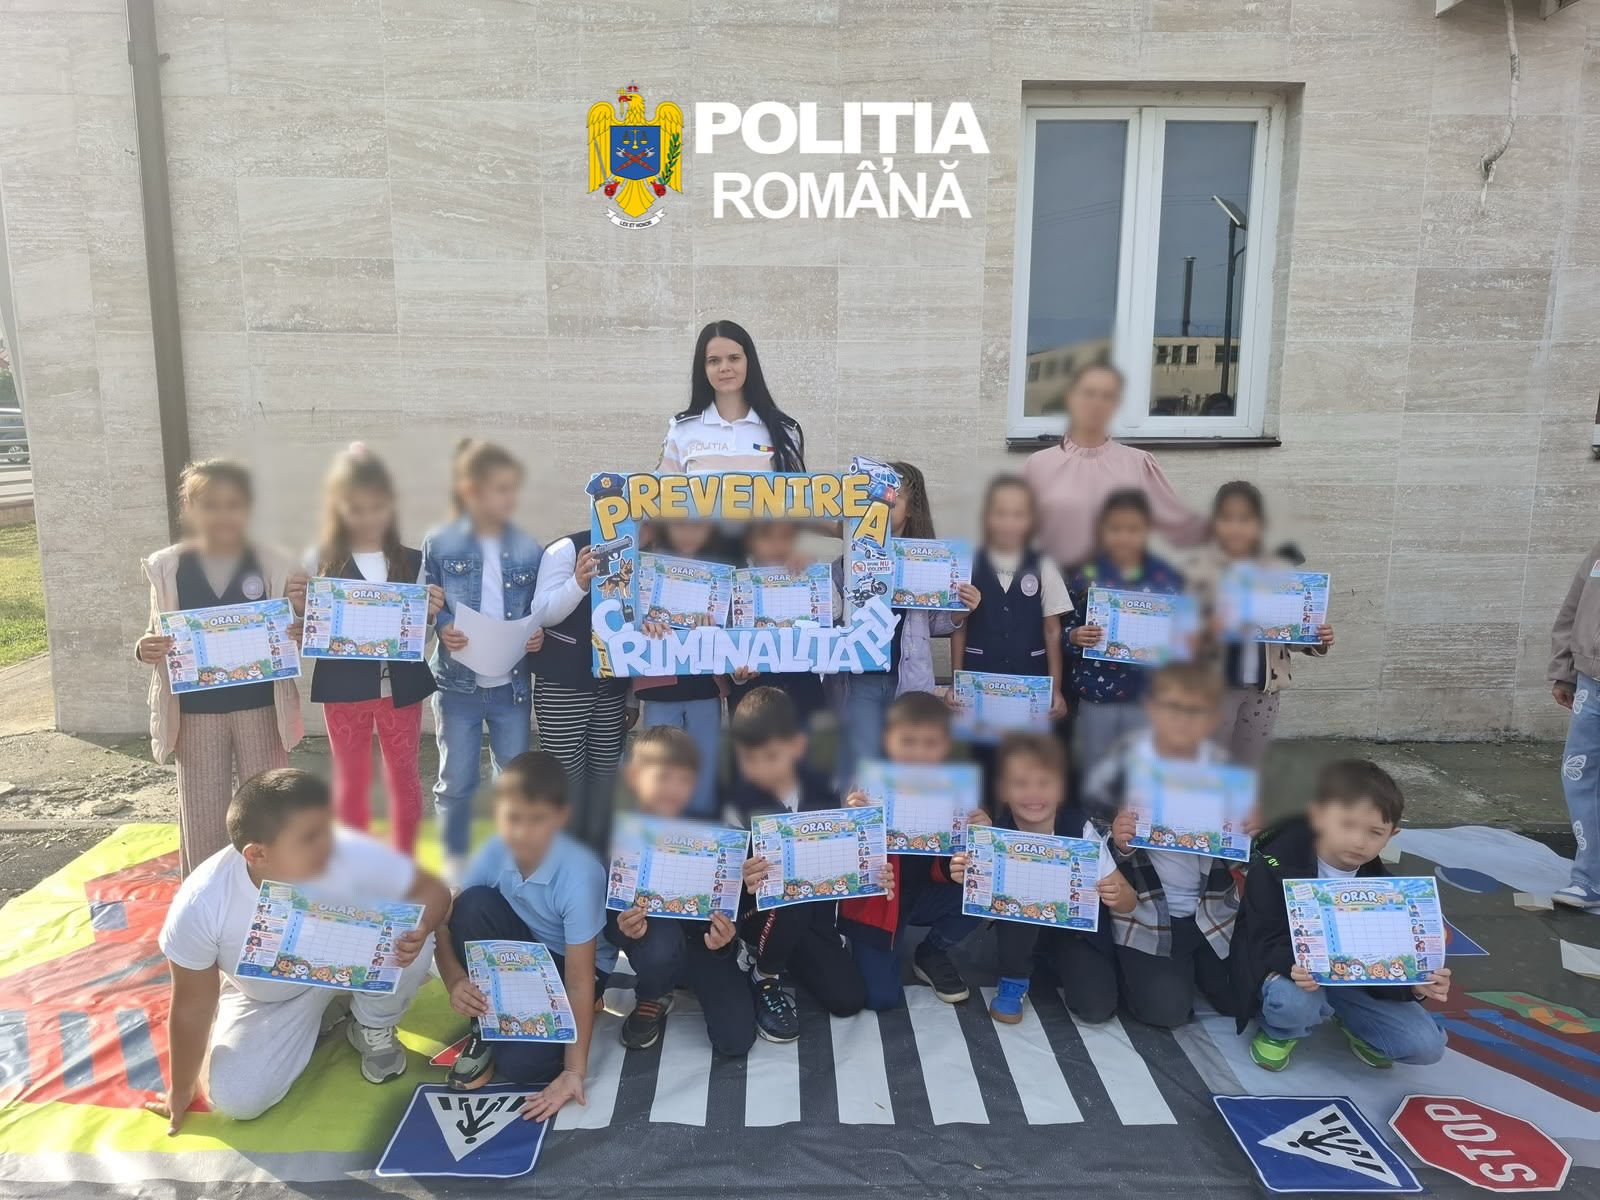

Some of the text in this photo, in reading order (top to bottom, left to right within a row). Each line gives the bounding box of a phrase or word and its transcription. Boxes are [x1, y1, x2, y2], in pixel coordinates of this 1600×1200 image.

[593, 473, 891, 548] PREVENIREA
[909, 546, 935, 557] ORAR
[670, 566, 696, 577] ORAR
[766, 574, 792, 583] ORAR
[351, 588, 382, 601] ORAR
[1125, 599, 1153, 611] ORAR
[208, 614, 242, 628] ORAR
[987, 681, 1013, 692] ORAR
[801, 821, 833, 834] ORAR
[1014, 842, 1048, 856] ORAR
[1341, 889, 1379, 904] ORAR
[499, 951, 523, 965] ORAR
[1424, 1103, 1538, 1184] STOP
